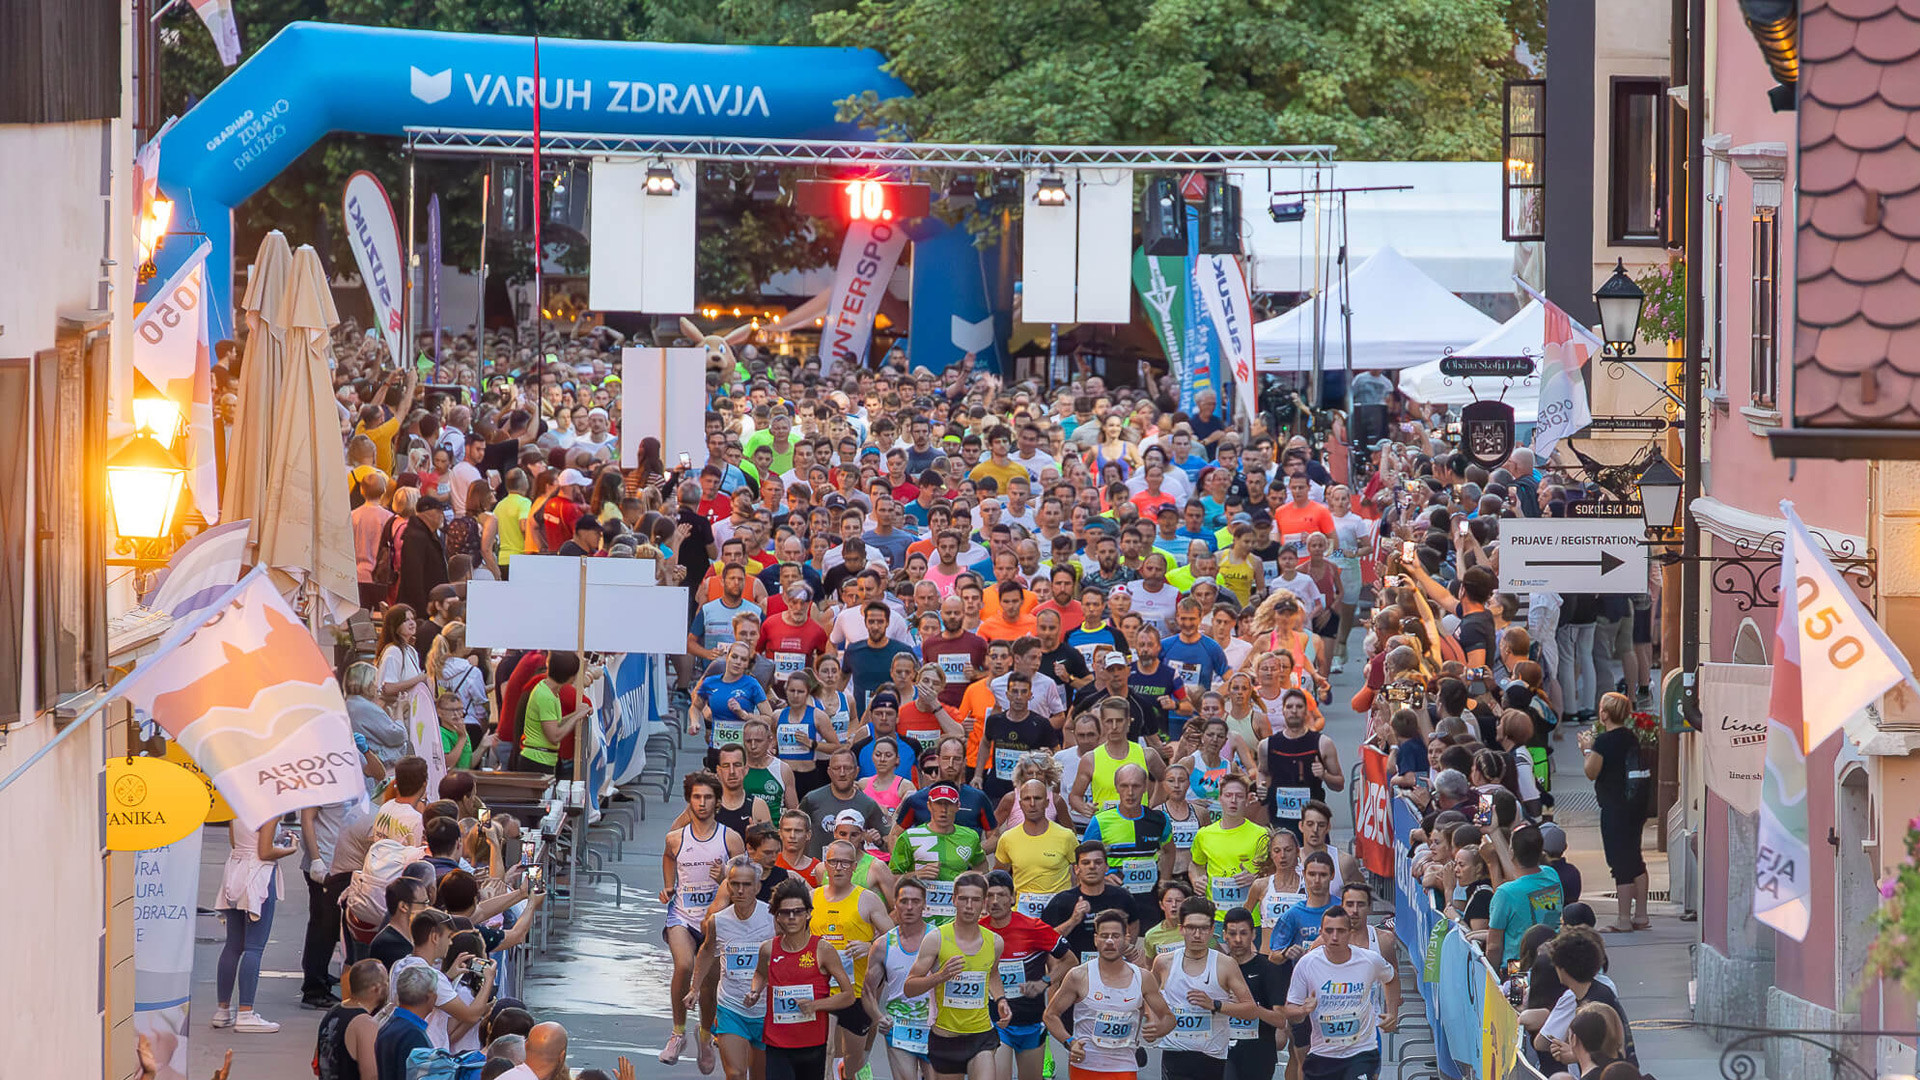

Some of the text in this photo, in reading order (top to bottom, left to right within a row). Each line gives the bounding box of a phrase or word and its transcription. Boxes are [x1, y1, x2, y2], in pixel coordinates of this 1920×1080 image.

[464, 73, 770, 117] VARUH ZDRAVJA
[1575, 504, 1622, 515] SOKOLSKI
[1511, 536, 1553, 545] PRIJAVE
[1561, 536, 1636, 545] REGISTRATION
[779, 662, 799, 671] 593
[944, 663, 965, 673] 200
[719, 730, 739, 740] 866
[1729, 771, 1751, 780] linen
[1282, 798, 1303, 808] 461
[106, 811, 166, 827] ANIKA
[1129, 870, 1151, 881] 600
[690, 892, 713, 904] 402
[930, 892, 954, 903] 277
[1219, 888, 1241, 899] 141
[736, 955, 753, 966] 67
[952, 983, 980, 995] 229
[1176, 1016, 1203, 1028] 607
[1327, 1020, 1354, 1034] 347
[906, 1028, 923, 1040] 13
[1102, 1022, 1129, 1036] 280
